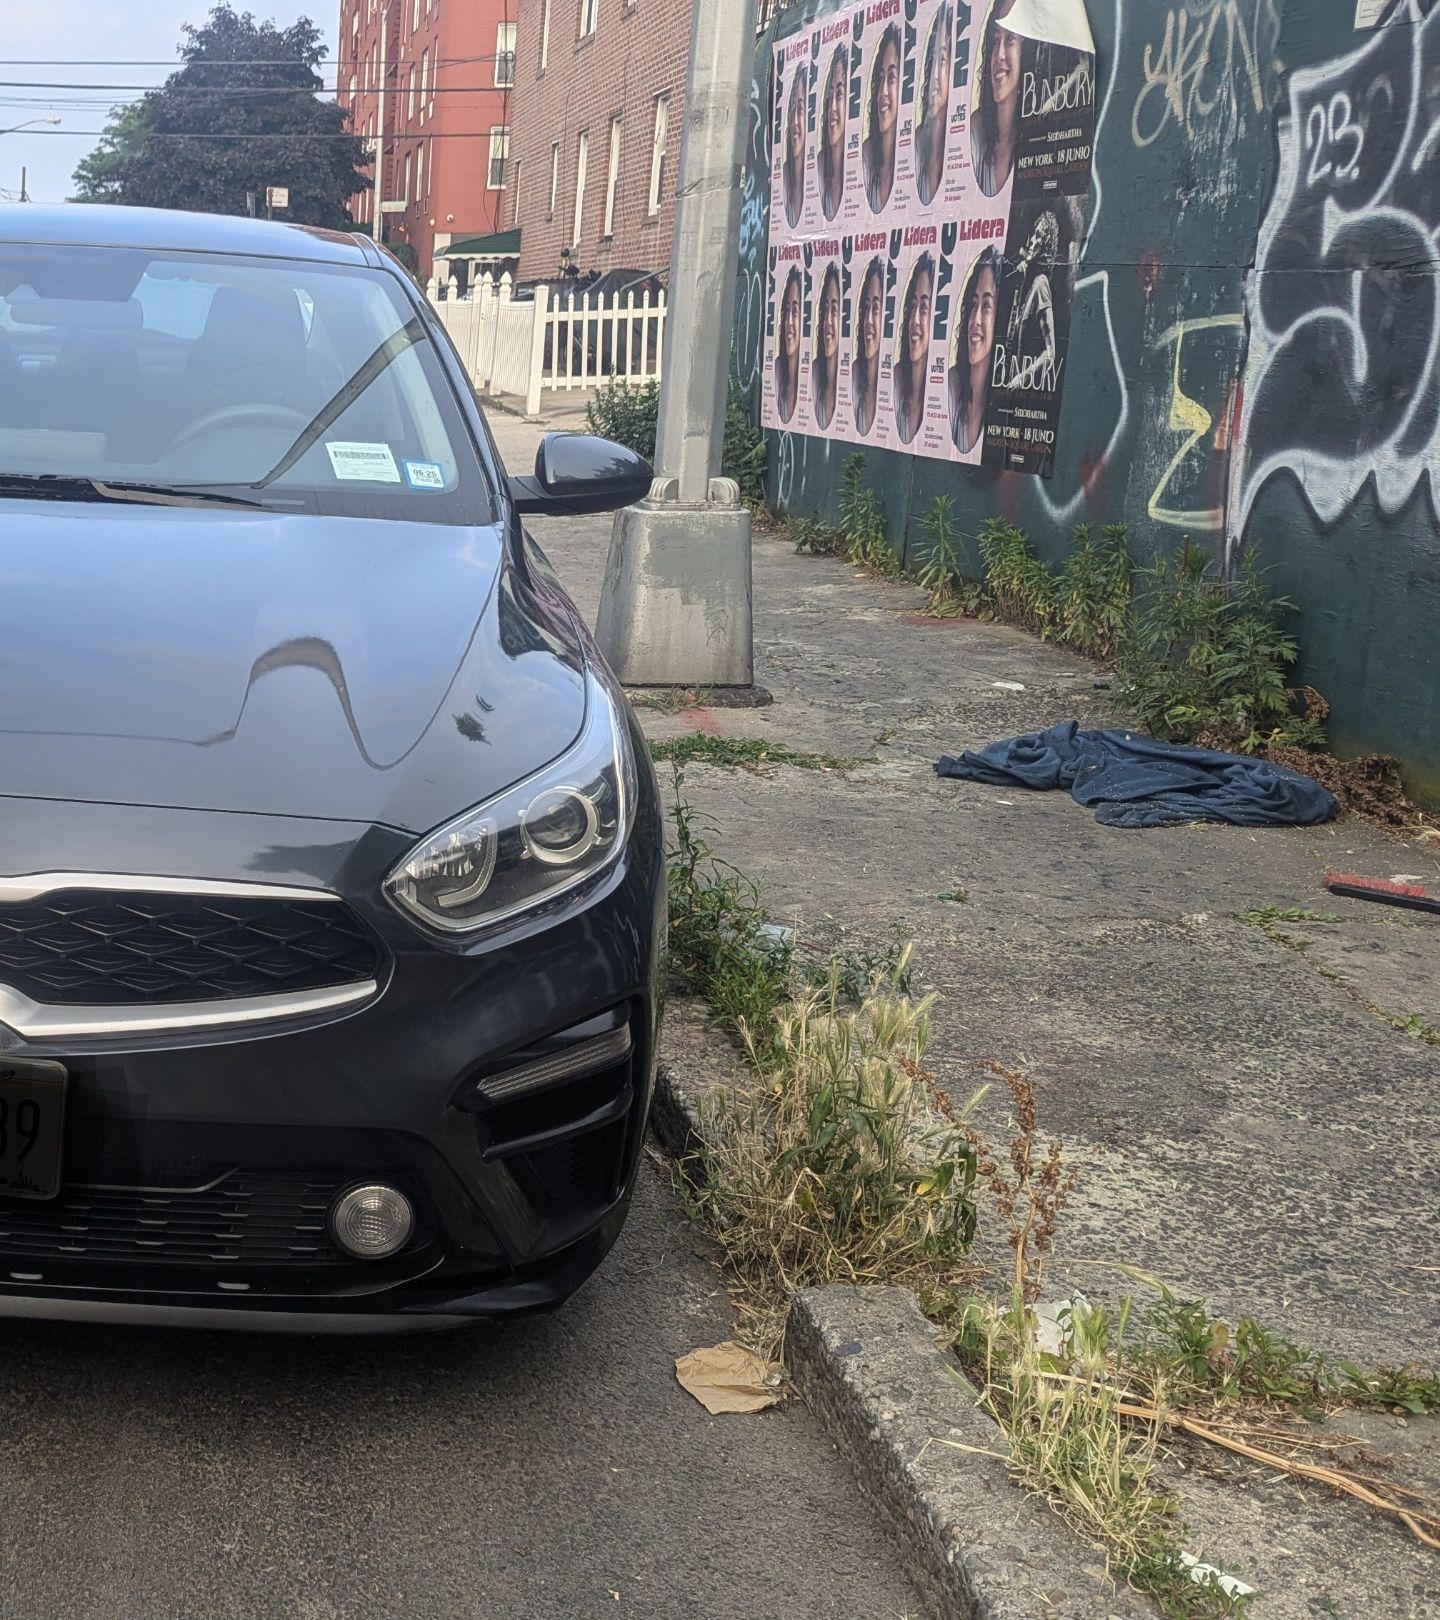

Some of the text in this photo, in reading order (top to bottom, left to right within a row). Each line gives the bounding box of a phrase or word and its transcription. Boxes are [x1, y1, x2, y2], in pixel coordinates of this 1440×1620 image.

[865, 0, 900, 25] Lidera
[822, 18, 850, 45] Lidera
[785, 38, 809, 61] Lidera
[1021, 69, 1095, 118] BUNBURY
[1018, 145, 1090, 169] NEW YORK 18 JUNIO
[903, 225, 938, 246] Lidera
[960, 218, 1006, 241] Lidera
[778, 243, 801, 261] Lidera
[814, 239, 840, 257] Lidera
[854, 232, 887, 252] Lidera
[991, 344, 1064, 392] BUNBURY
[987, 424, 1055, 444] NEW YORK 18 JUNIO
